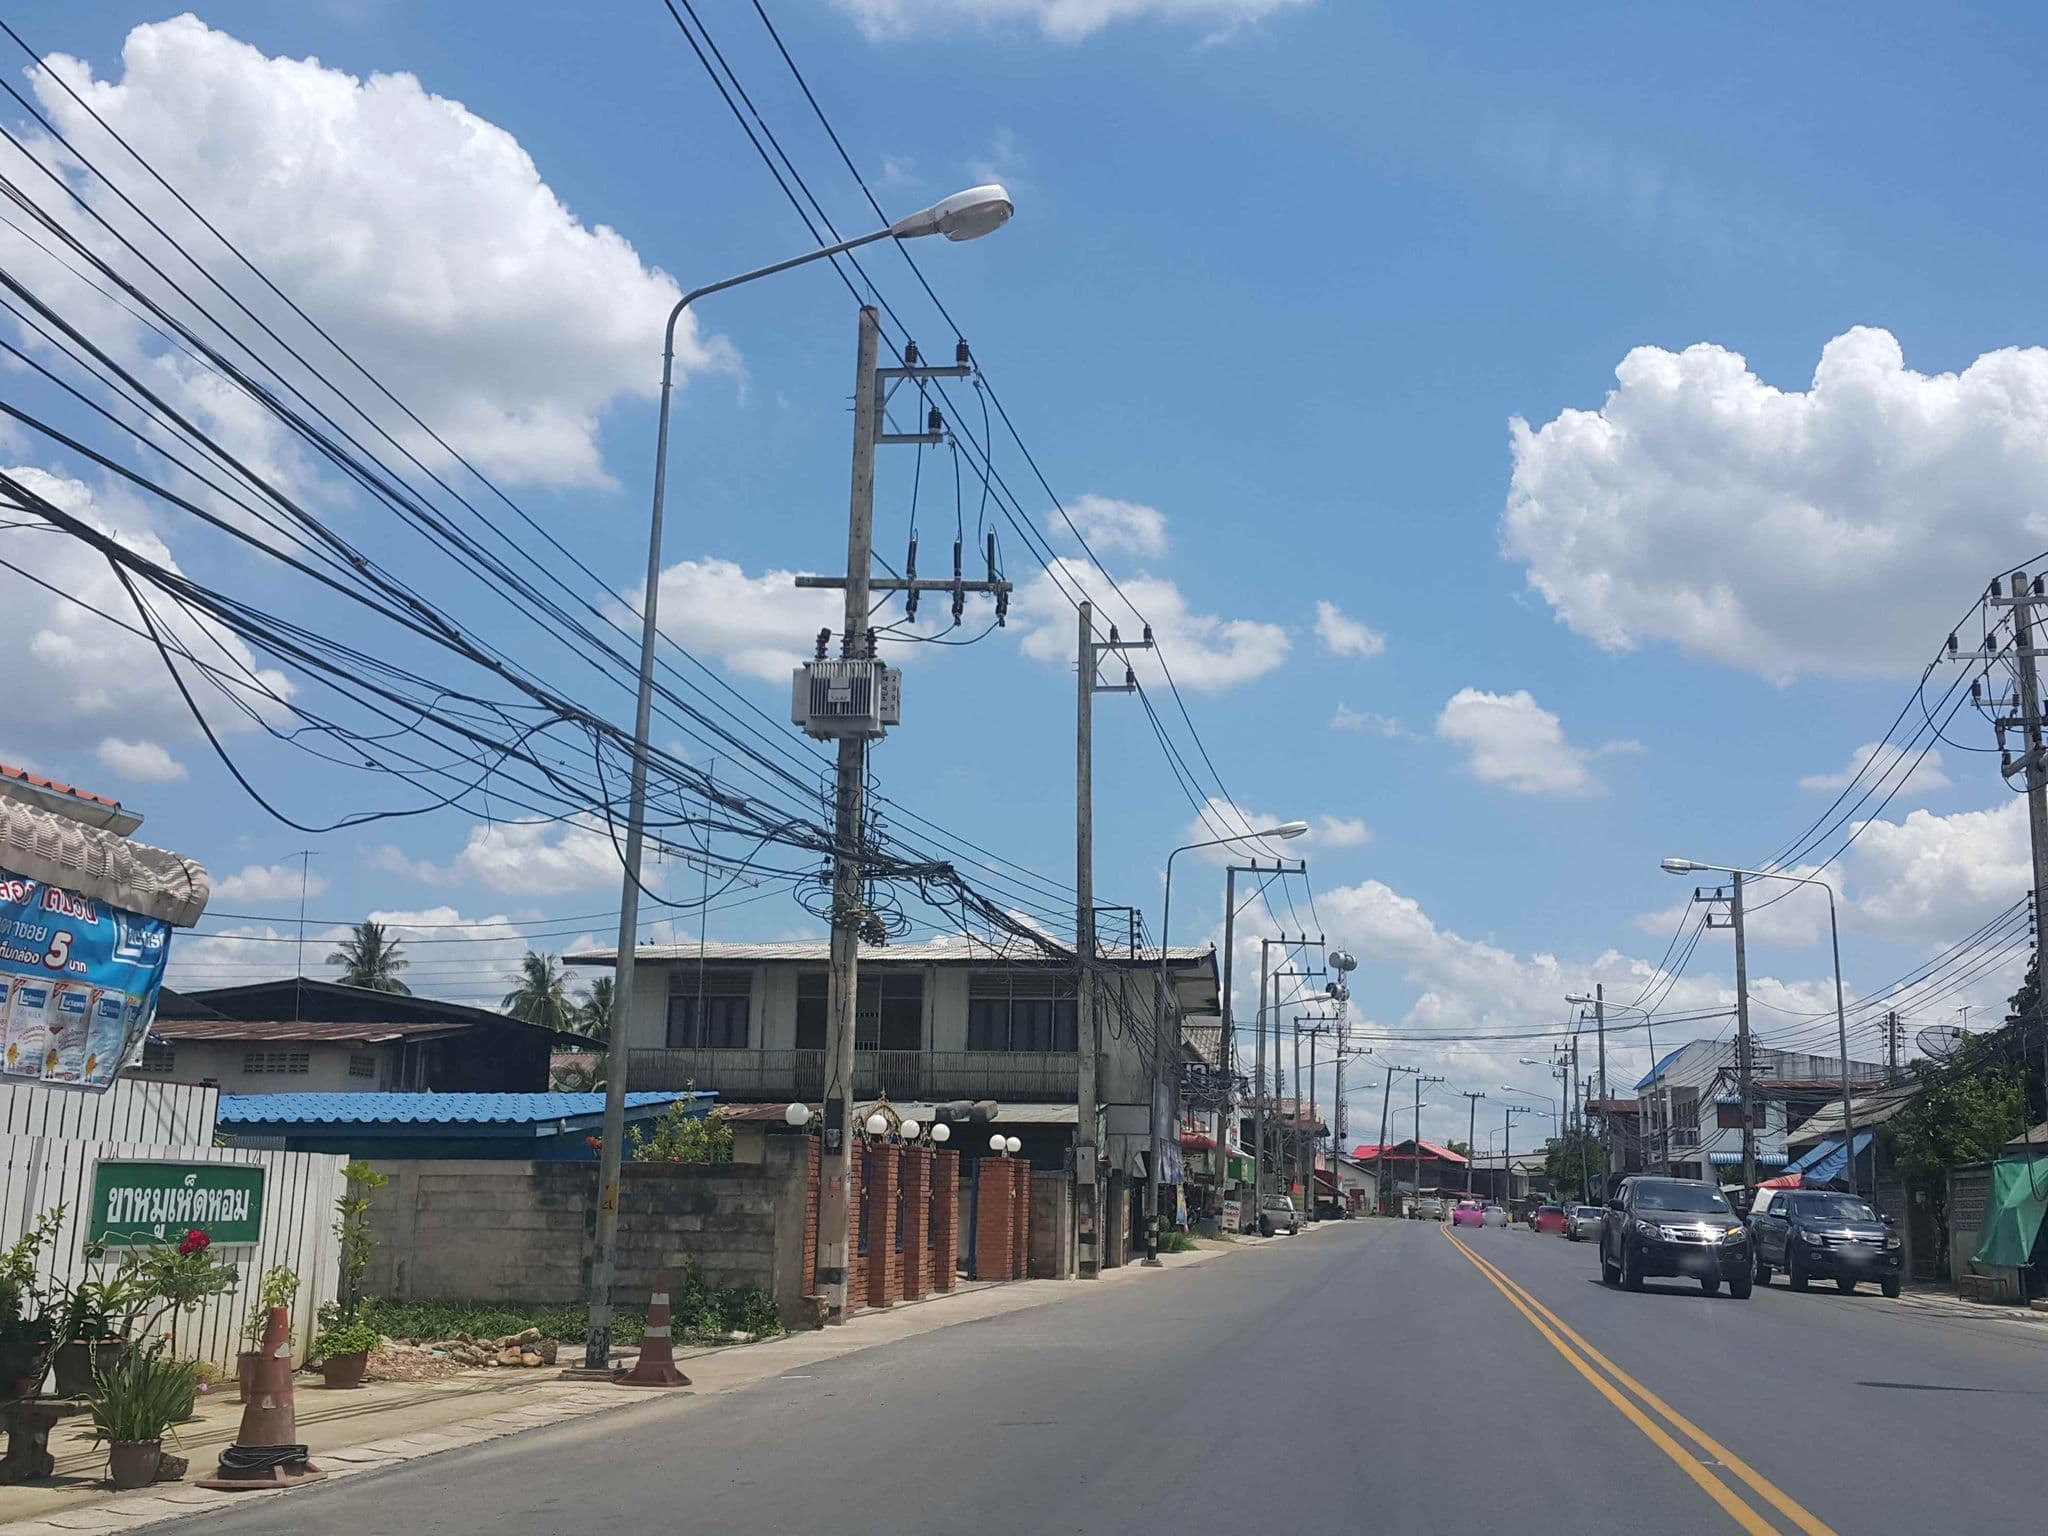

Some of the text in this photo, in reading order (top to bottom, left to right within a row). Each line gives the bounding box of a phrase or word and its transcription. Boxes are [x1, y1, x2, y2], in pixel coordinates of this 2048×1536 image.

[0, 919, 48, 942] ตาซอย
[43, 929, 73, 970] 5
[69, 959, 88, 973] บาท
[106, 1174, 250, 1239] ขาหมูเห็ดหอม
